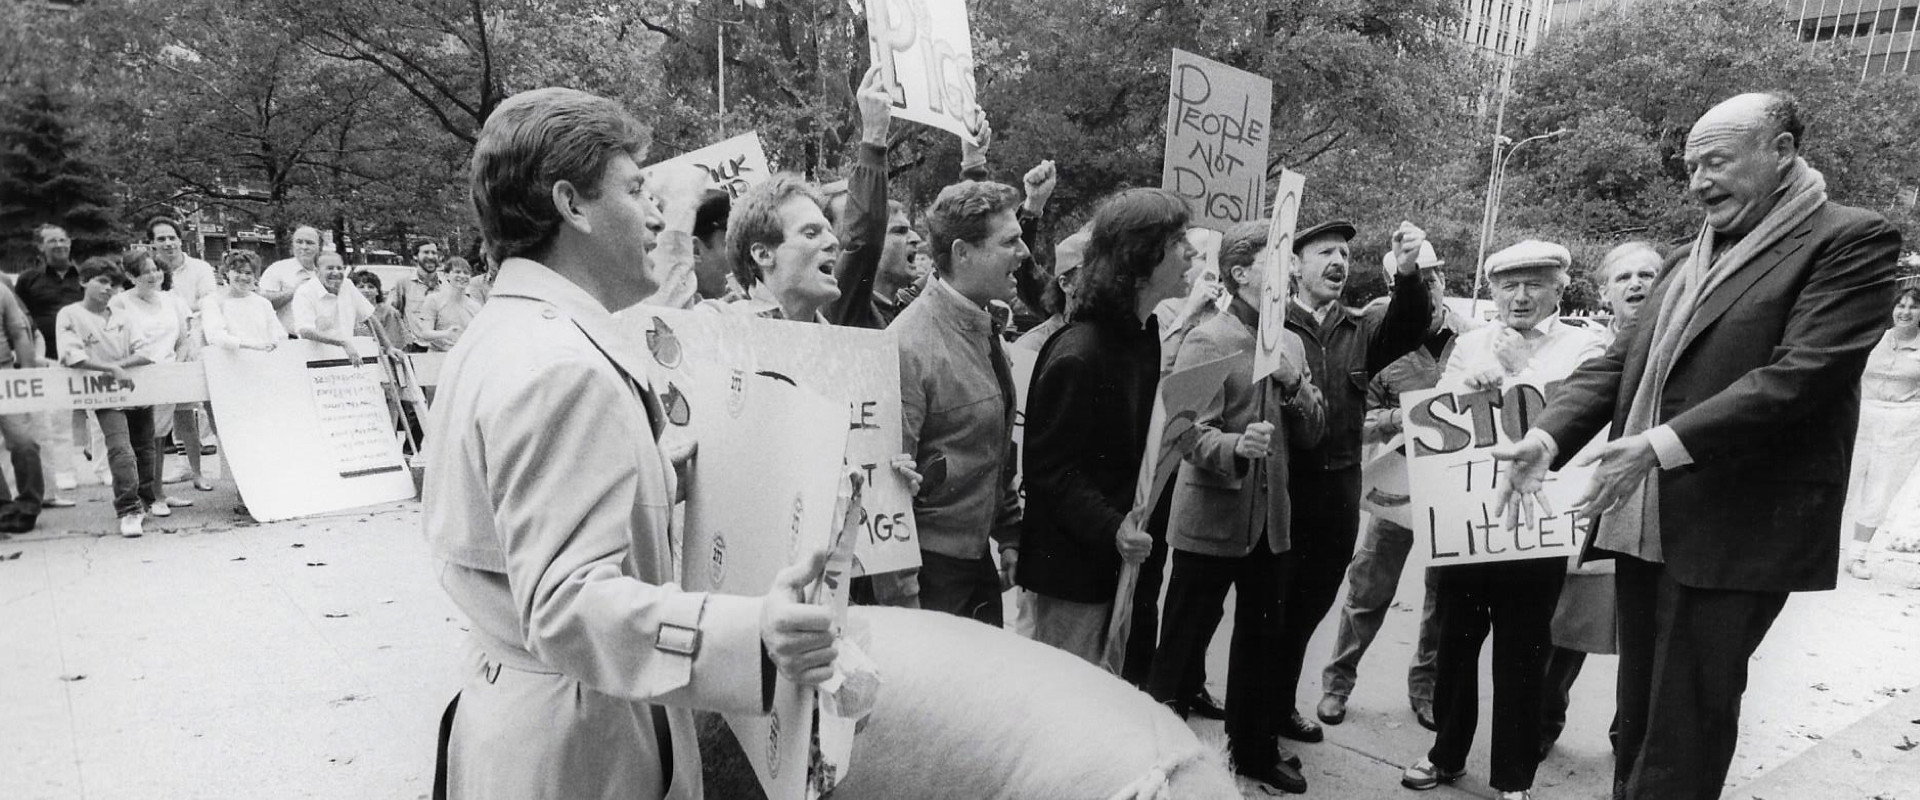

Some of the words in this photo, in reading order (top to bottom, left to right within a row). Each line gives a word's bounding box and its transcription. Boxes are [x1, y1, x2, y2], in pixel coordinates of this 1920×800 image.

[1173, 64, 1263, 155] PEOPLE
[1188, 140, 1244, 178] NOT
[1409, 384, 1547, 457] STO
